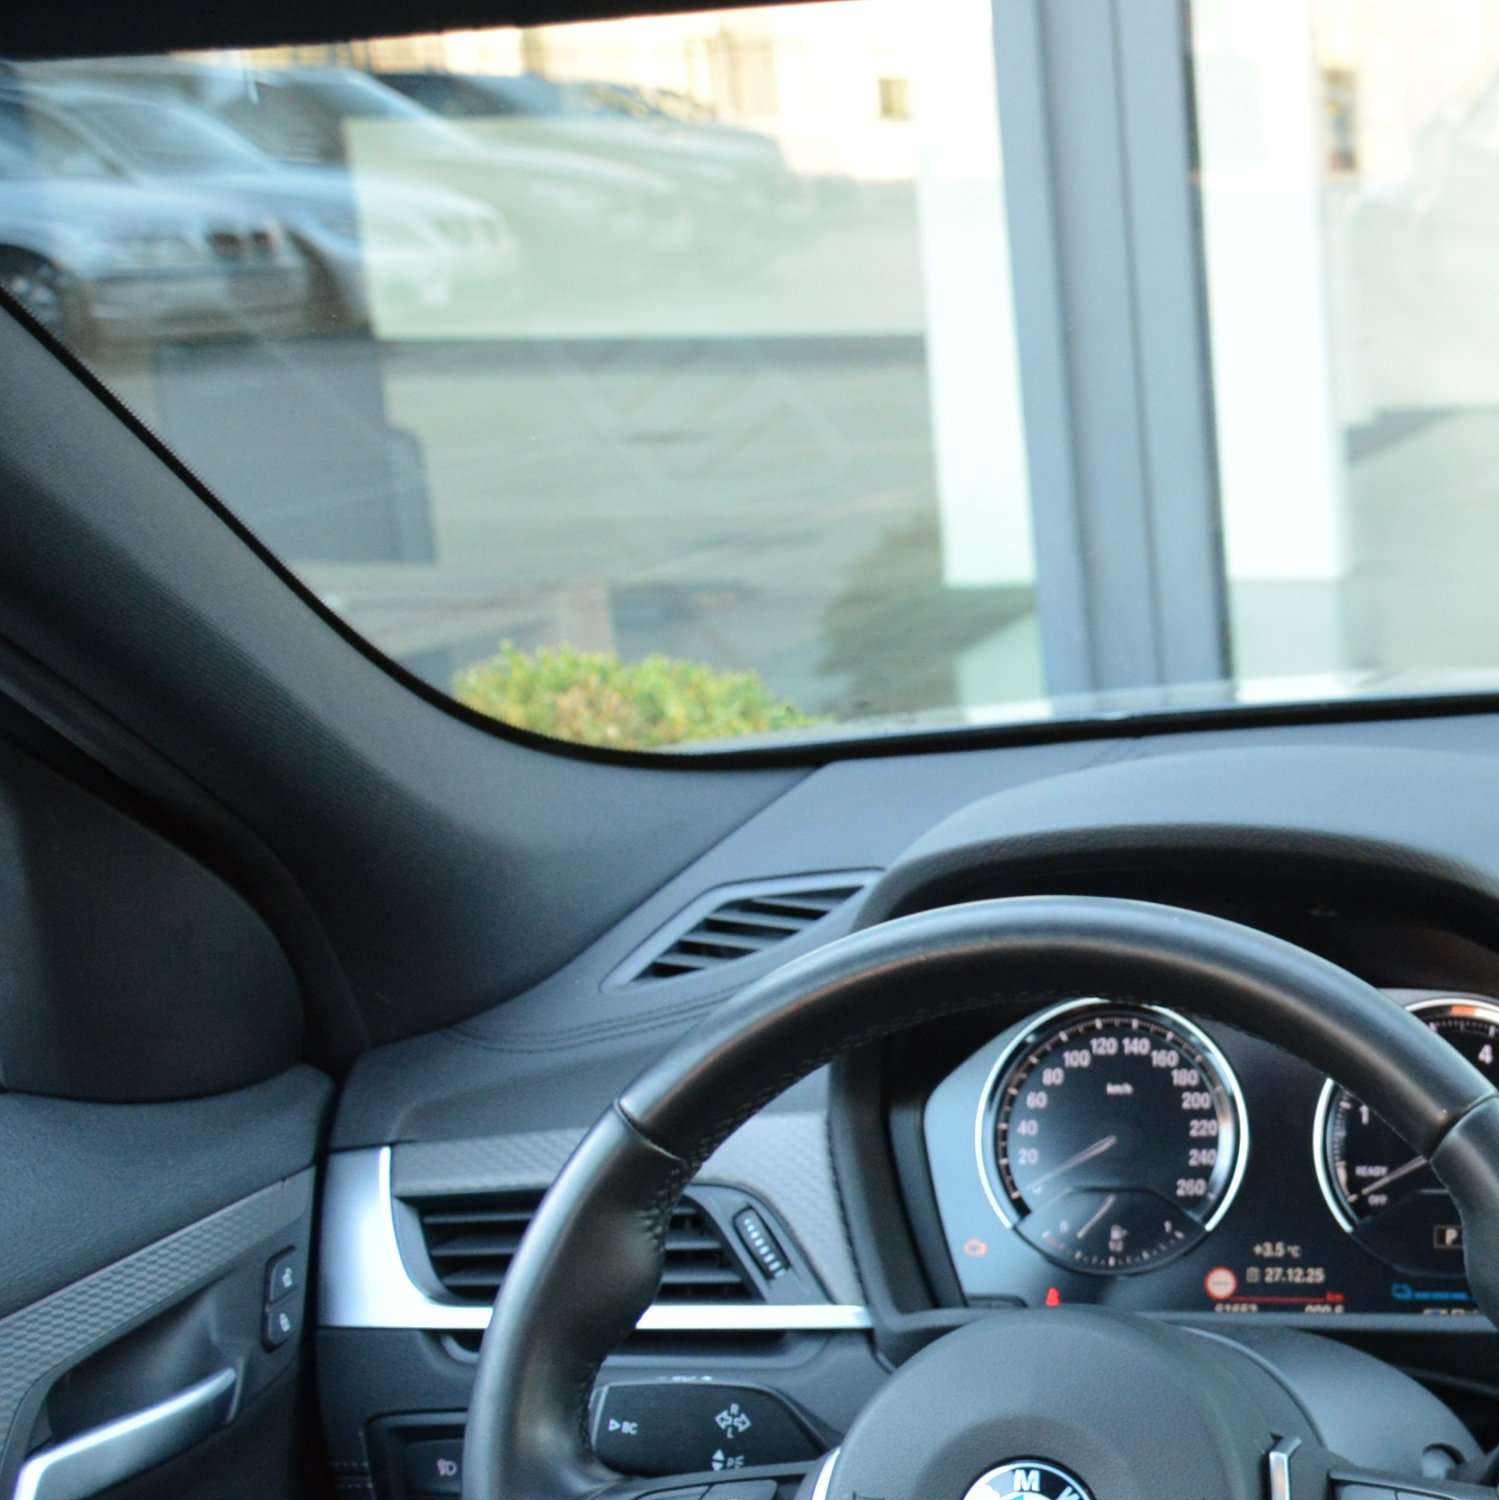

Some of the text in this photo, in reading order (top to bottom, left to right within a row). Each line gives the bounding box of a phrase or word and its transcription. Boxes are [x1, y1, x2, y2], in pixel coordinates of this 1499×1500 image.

[1090, 1037, 1118, 1055] 120
[1122, 1037, 1151, 1055] 140
[1478, 1044, 1493, 1064] 4
[1063, 1051, 1091, 1068] 100
[1151, 1051, 1179, 1068] 160
[1042, 1067, 1064, 1086] 80
[1171, 1068, 1199, 1087] 180
[1026, 1091, 1048, 1109] 60
[1181, 1091, 1212, 1109] 200
[1359, 1104, 1370, 1125] 1
[1017, 1120, 1039, 1136] 40
[1189, 1119, 1218, 1137] 220
[1018, 1148, 1039, 1165] 20
[1188, 1147, 1218, 1166] 240
[1355, 1165, 1388, 1177] READY
[1176, 1179, 1207, 1197] 260
[1445, 1229, 1457, 1246] P
[1264, 1267, 1326, 1284] 27.12.25
[730, 1403, 739, 1415] R
